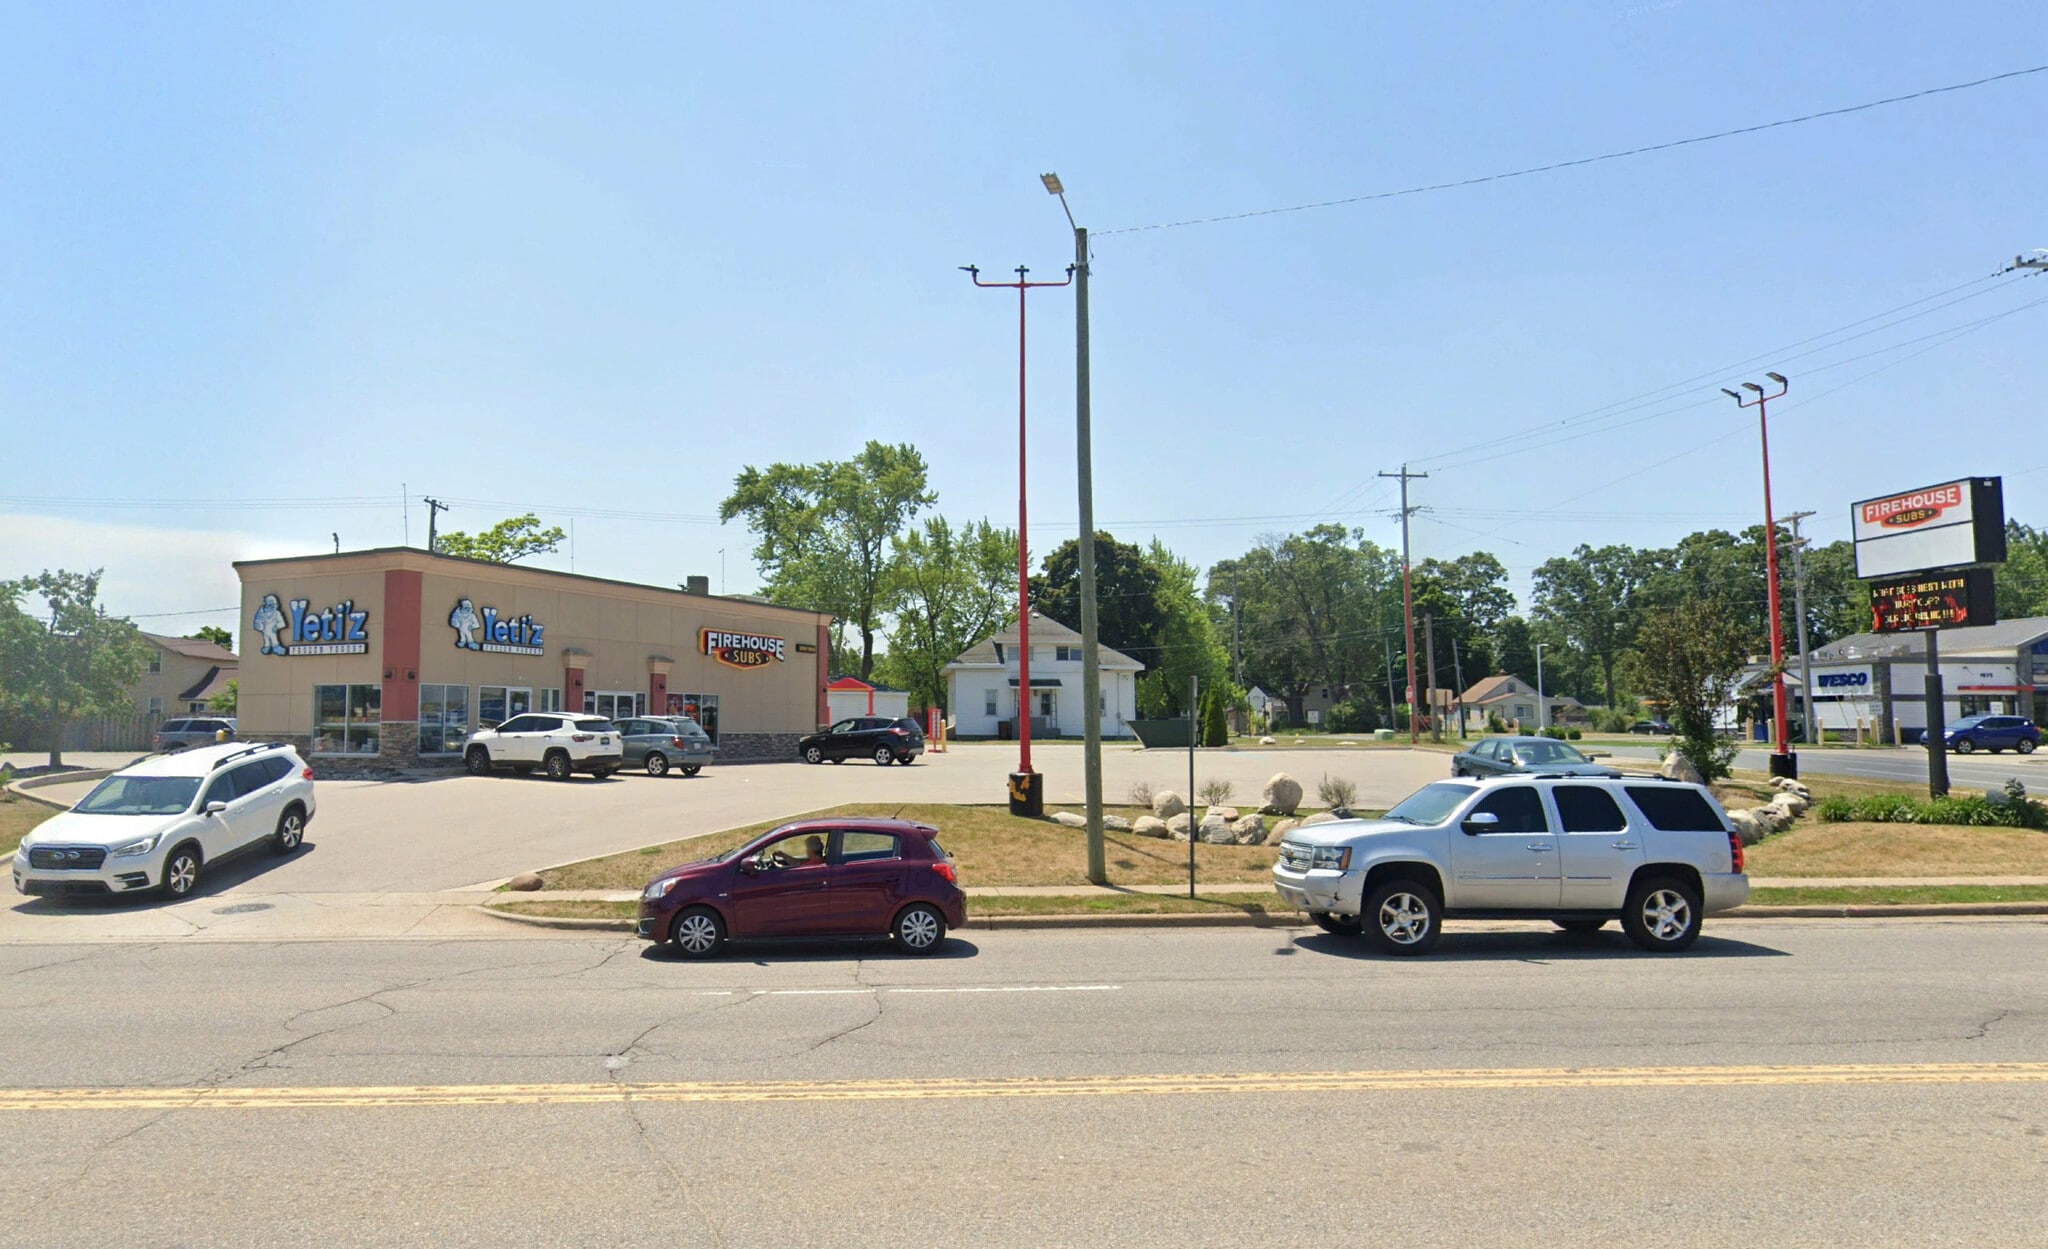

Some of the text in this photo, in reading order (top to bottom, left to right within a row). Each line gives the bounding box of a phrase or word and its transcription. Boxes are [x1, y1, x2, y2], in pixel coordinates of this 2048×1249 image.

[1865, 487, 1958, 522] FIREHOUSE
[1896, 509, 1926, 523] SUBS
[290, 599, 368, 642] Yeti'z
[482, 607, 544, 645] Yeti'z
[706, 631, 785, 661] FIREHOUSE
[733, 650, 762, 664] SUBS
[1817, 672, 1868, 687] WESCO
